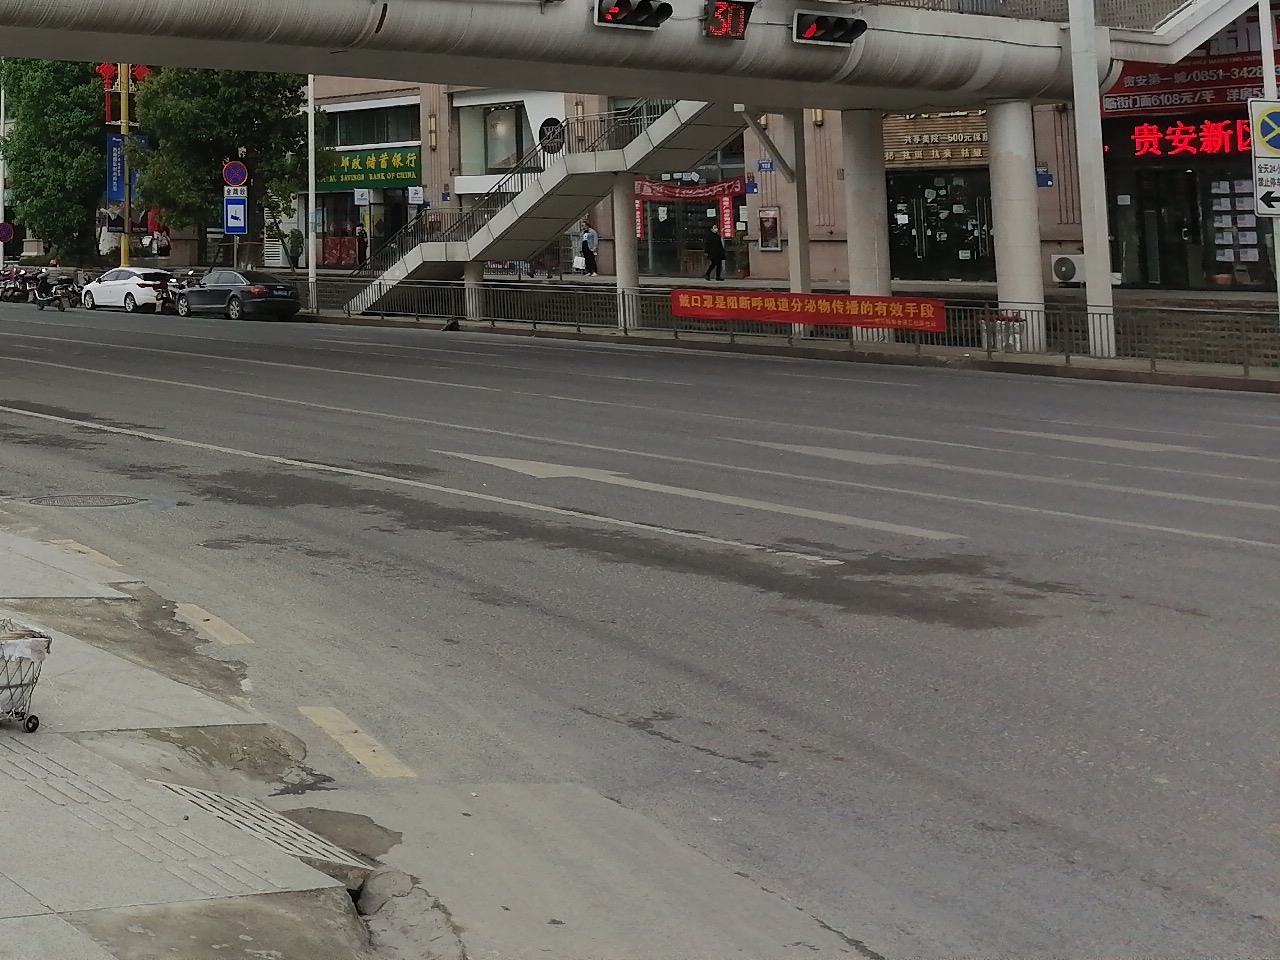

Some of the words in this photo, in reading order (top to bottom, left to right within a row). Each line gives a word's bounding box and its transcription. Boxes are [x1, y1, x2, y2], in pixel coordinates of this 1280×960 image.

[678, 292, 936, 319] 戴口罩是阻断呼吸道分泌物传播的有效手段
